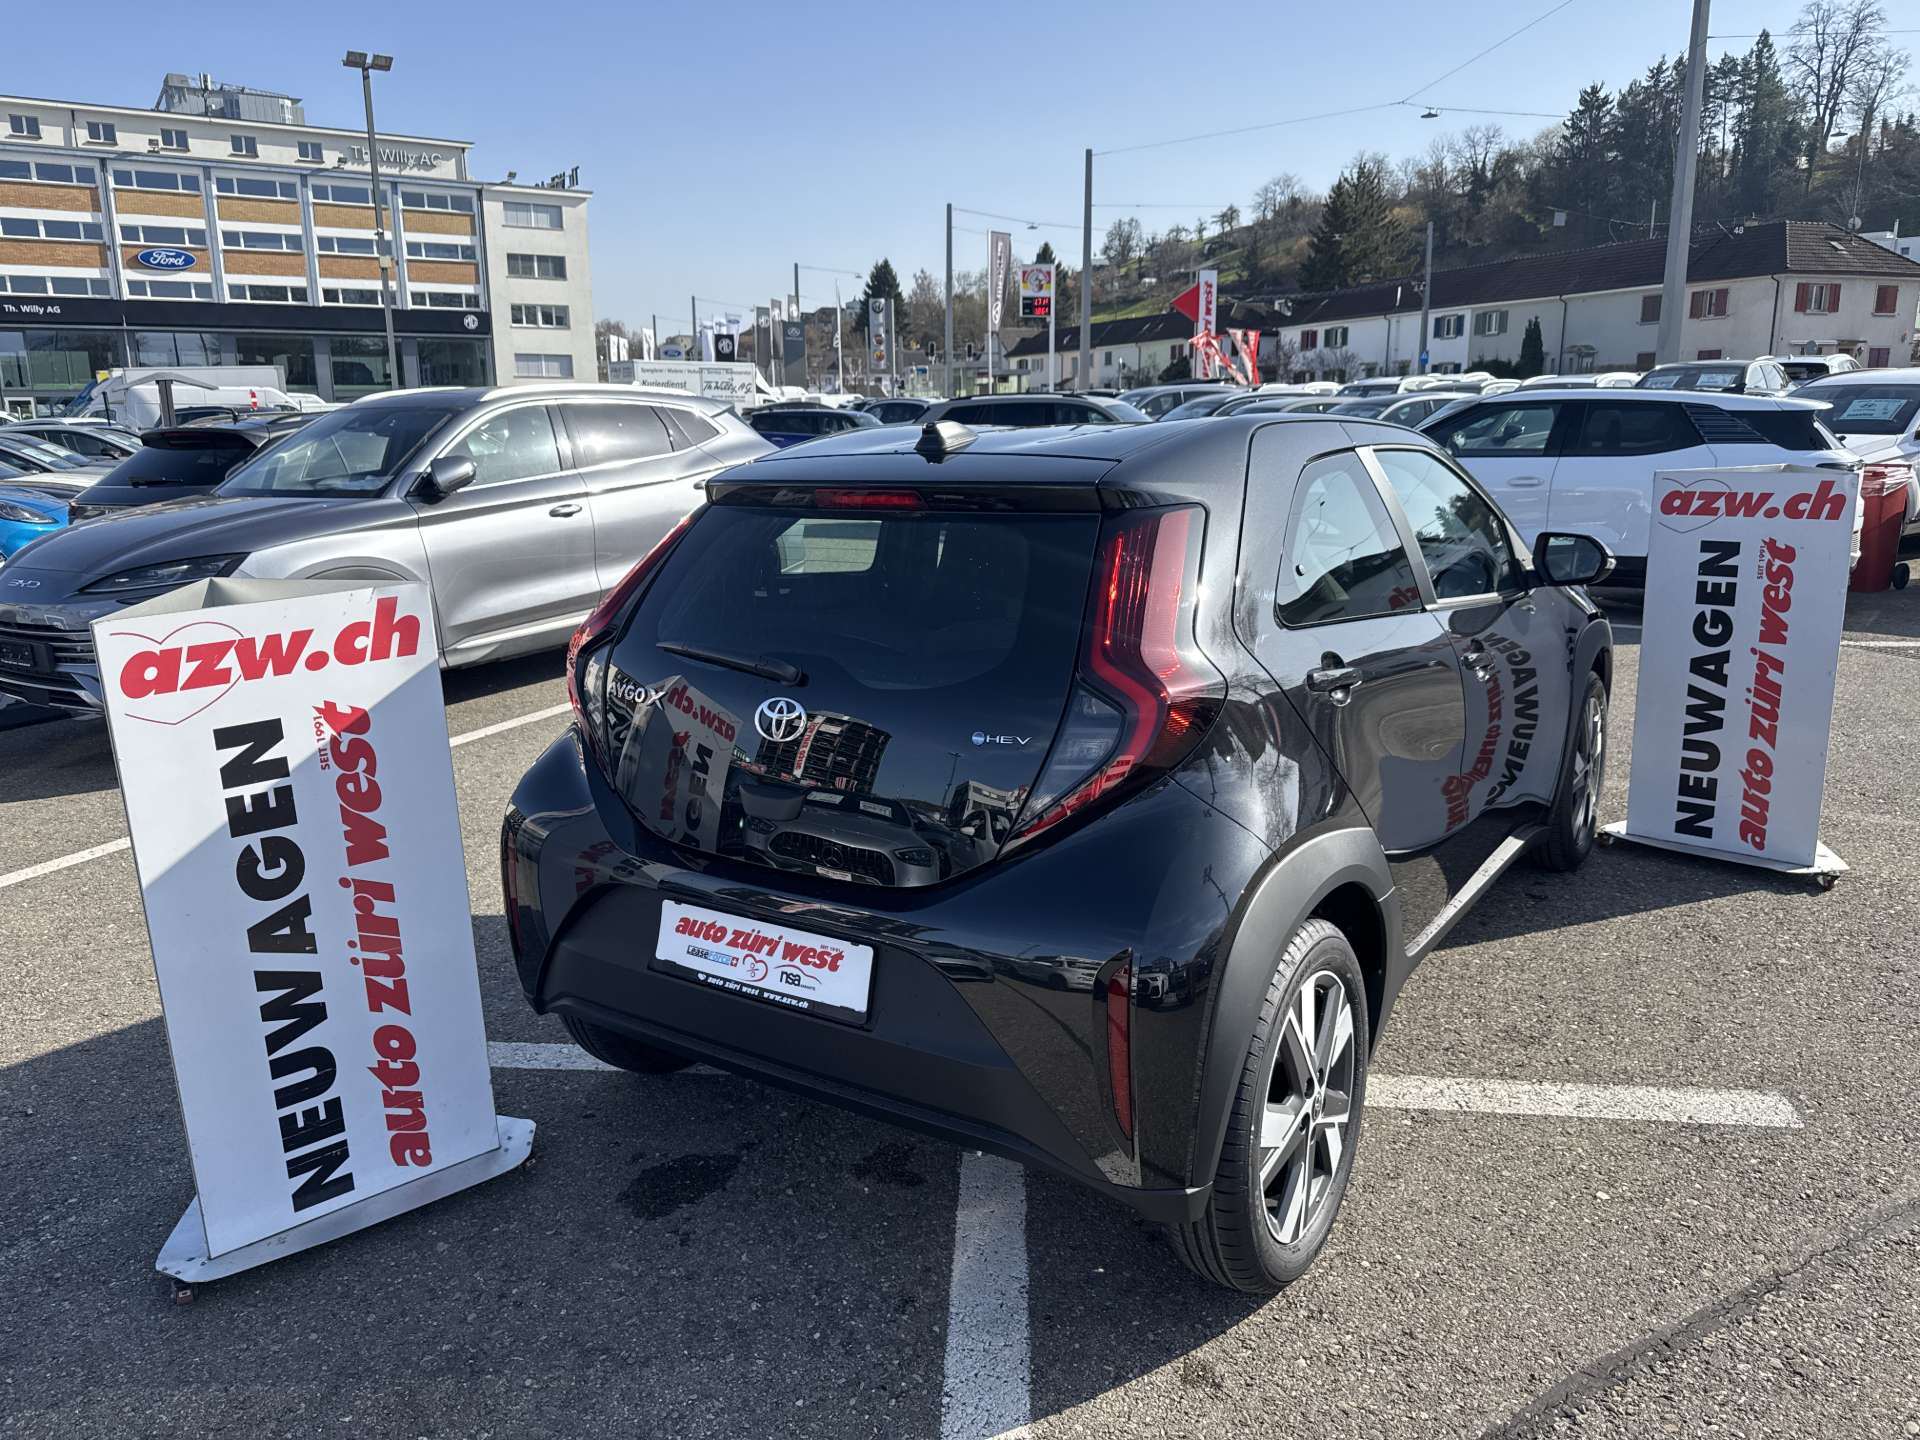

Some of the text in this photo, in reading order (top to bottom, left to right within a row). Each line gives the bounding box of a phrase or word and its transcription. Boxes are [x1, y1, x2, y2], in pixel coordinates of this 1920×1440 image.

[380, 148, 417, 167] Willy
[420, 151, 443, 166] AG
[150, 251, 185, 266] Ford
[3, 304, 61, 315] Th. Willy AG
[1659, 480, 1848, 521] azw.ch
[120, 597, 420, 699] azw.ch
[608, 681, 646, 703] AYGO
[1674, 540, 1742, 839] NEUWAGEN
[1738, 537, 1796, 852] auto züri west
[313, 715, 330, 770] SEIT 1991
[986, 734, 1033, 745] HEV
[312, 699, 432, 1168] auto züri west
[675, 916, 845, 972] auto züri west
[214, 717, 355, 1213] NEUWAGEN
[780, 971, 802, 987] nsa
[742, 986, 760, 996] west
